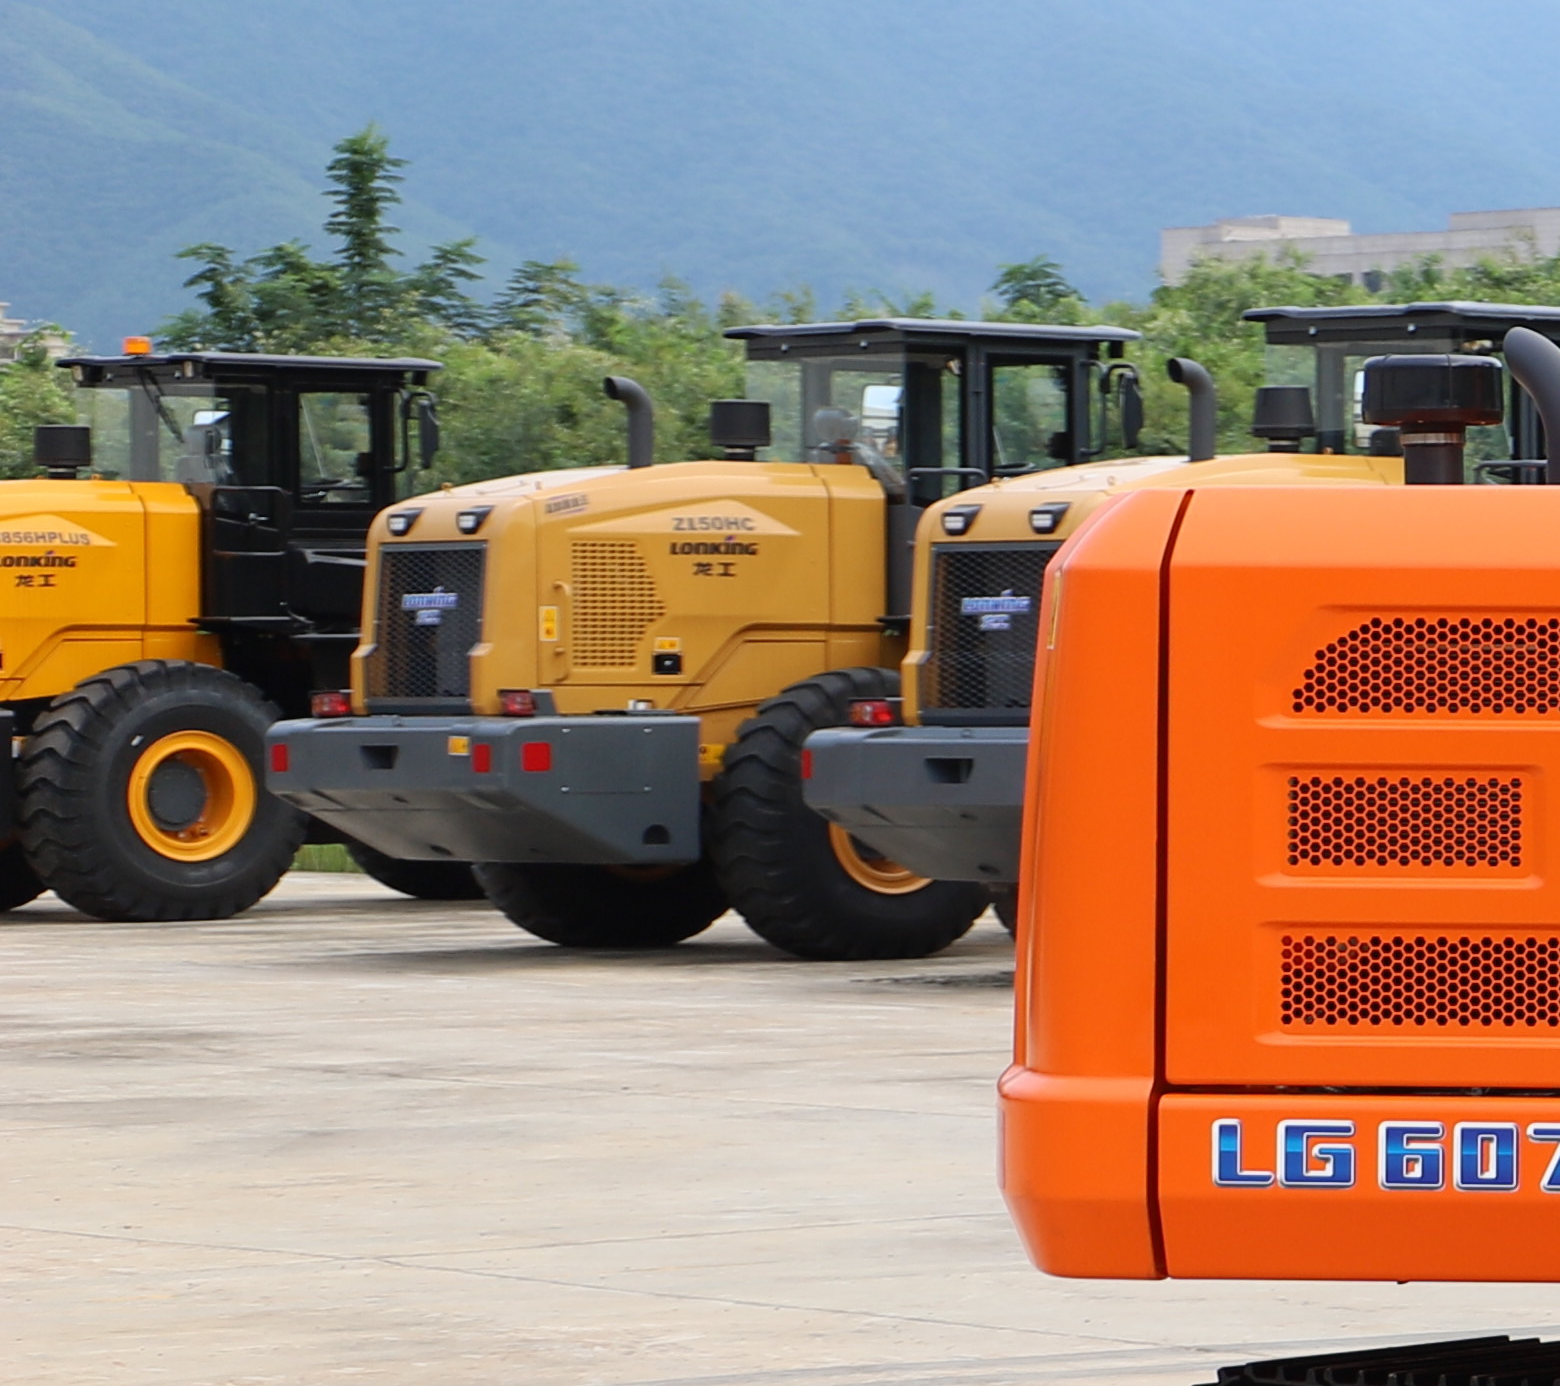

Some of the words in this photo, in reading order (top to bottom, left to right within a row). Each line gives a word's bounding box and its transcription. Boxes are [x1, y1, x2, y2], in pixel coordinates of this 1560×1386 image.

[0, 532, 91, 546] 856HPLUS
[692, 562, 737, 577] 龙工
[1211, 1118, 1356, 1190] LG
